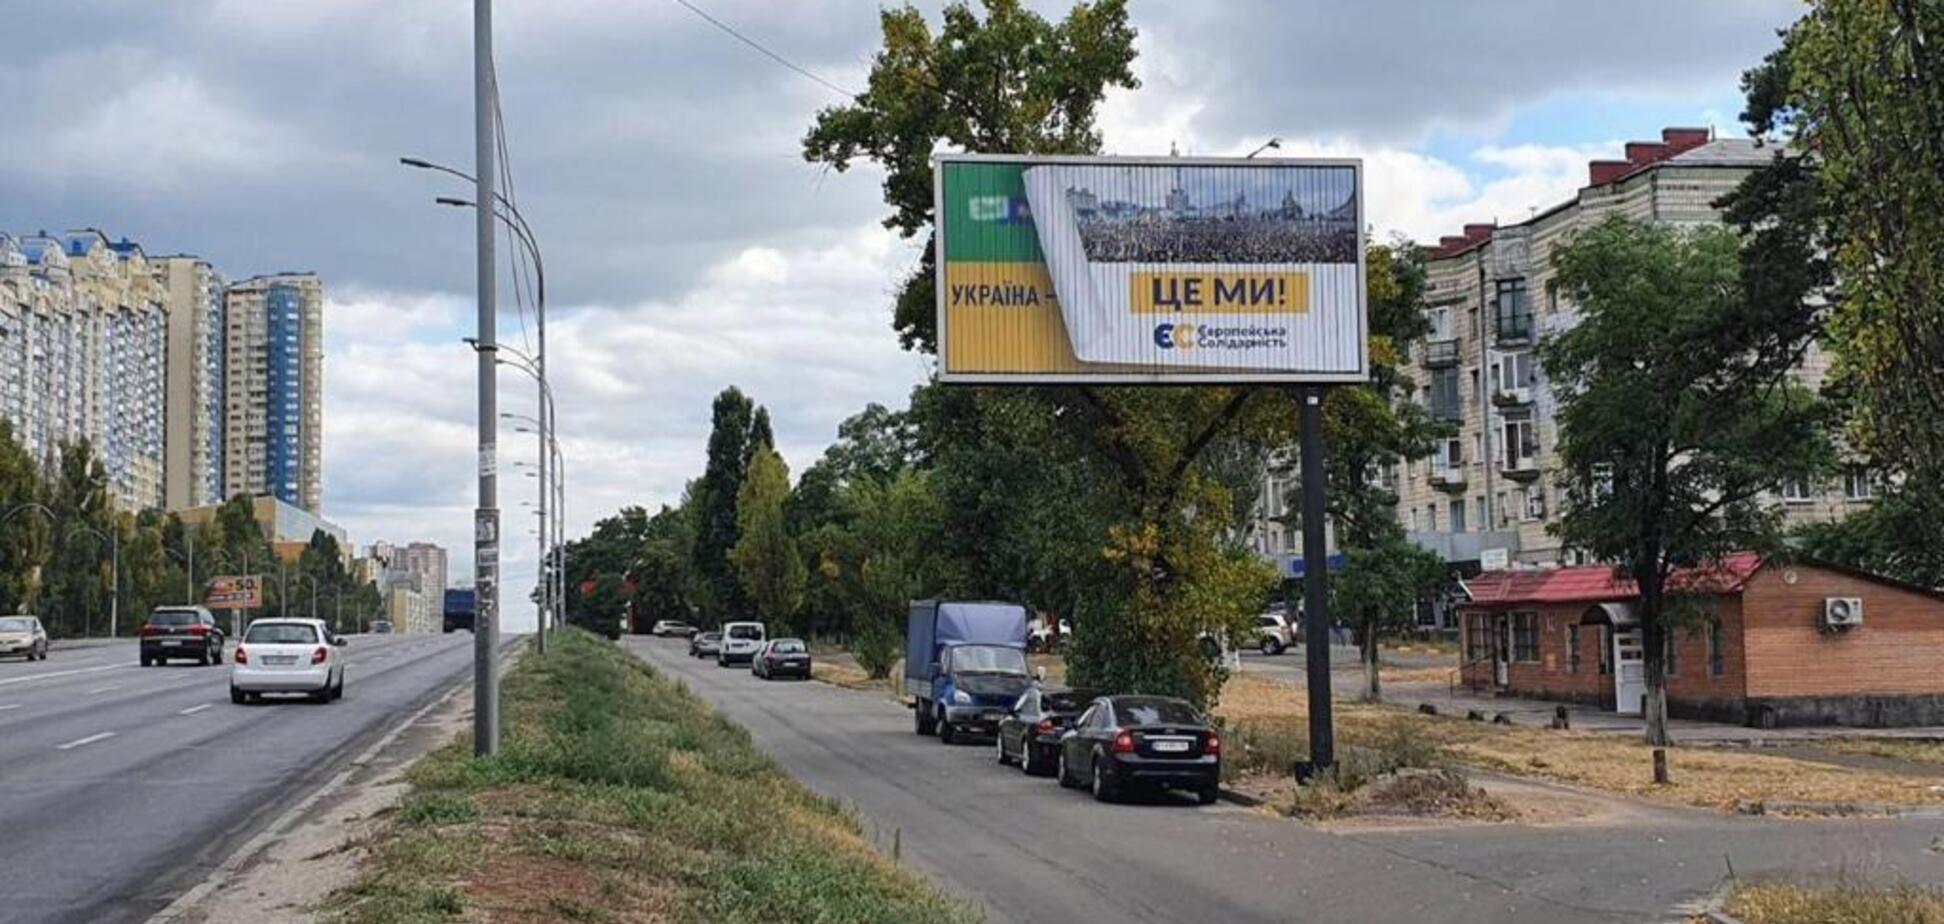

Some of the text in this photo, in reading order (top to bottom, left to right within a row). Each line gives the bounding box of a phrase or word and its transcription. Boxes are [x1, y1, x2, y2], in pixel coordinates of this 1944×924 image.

[952, 280, 1039, 306] УКРАЇНА
[1152, 278, 1285, 311] ЦЕ МИ!
[1197, 324, 1286, 338] Європейська
[1197, 338, 1287, 349] Солідарність
